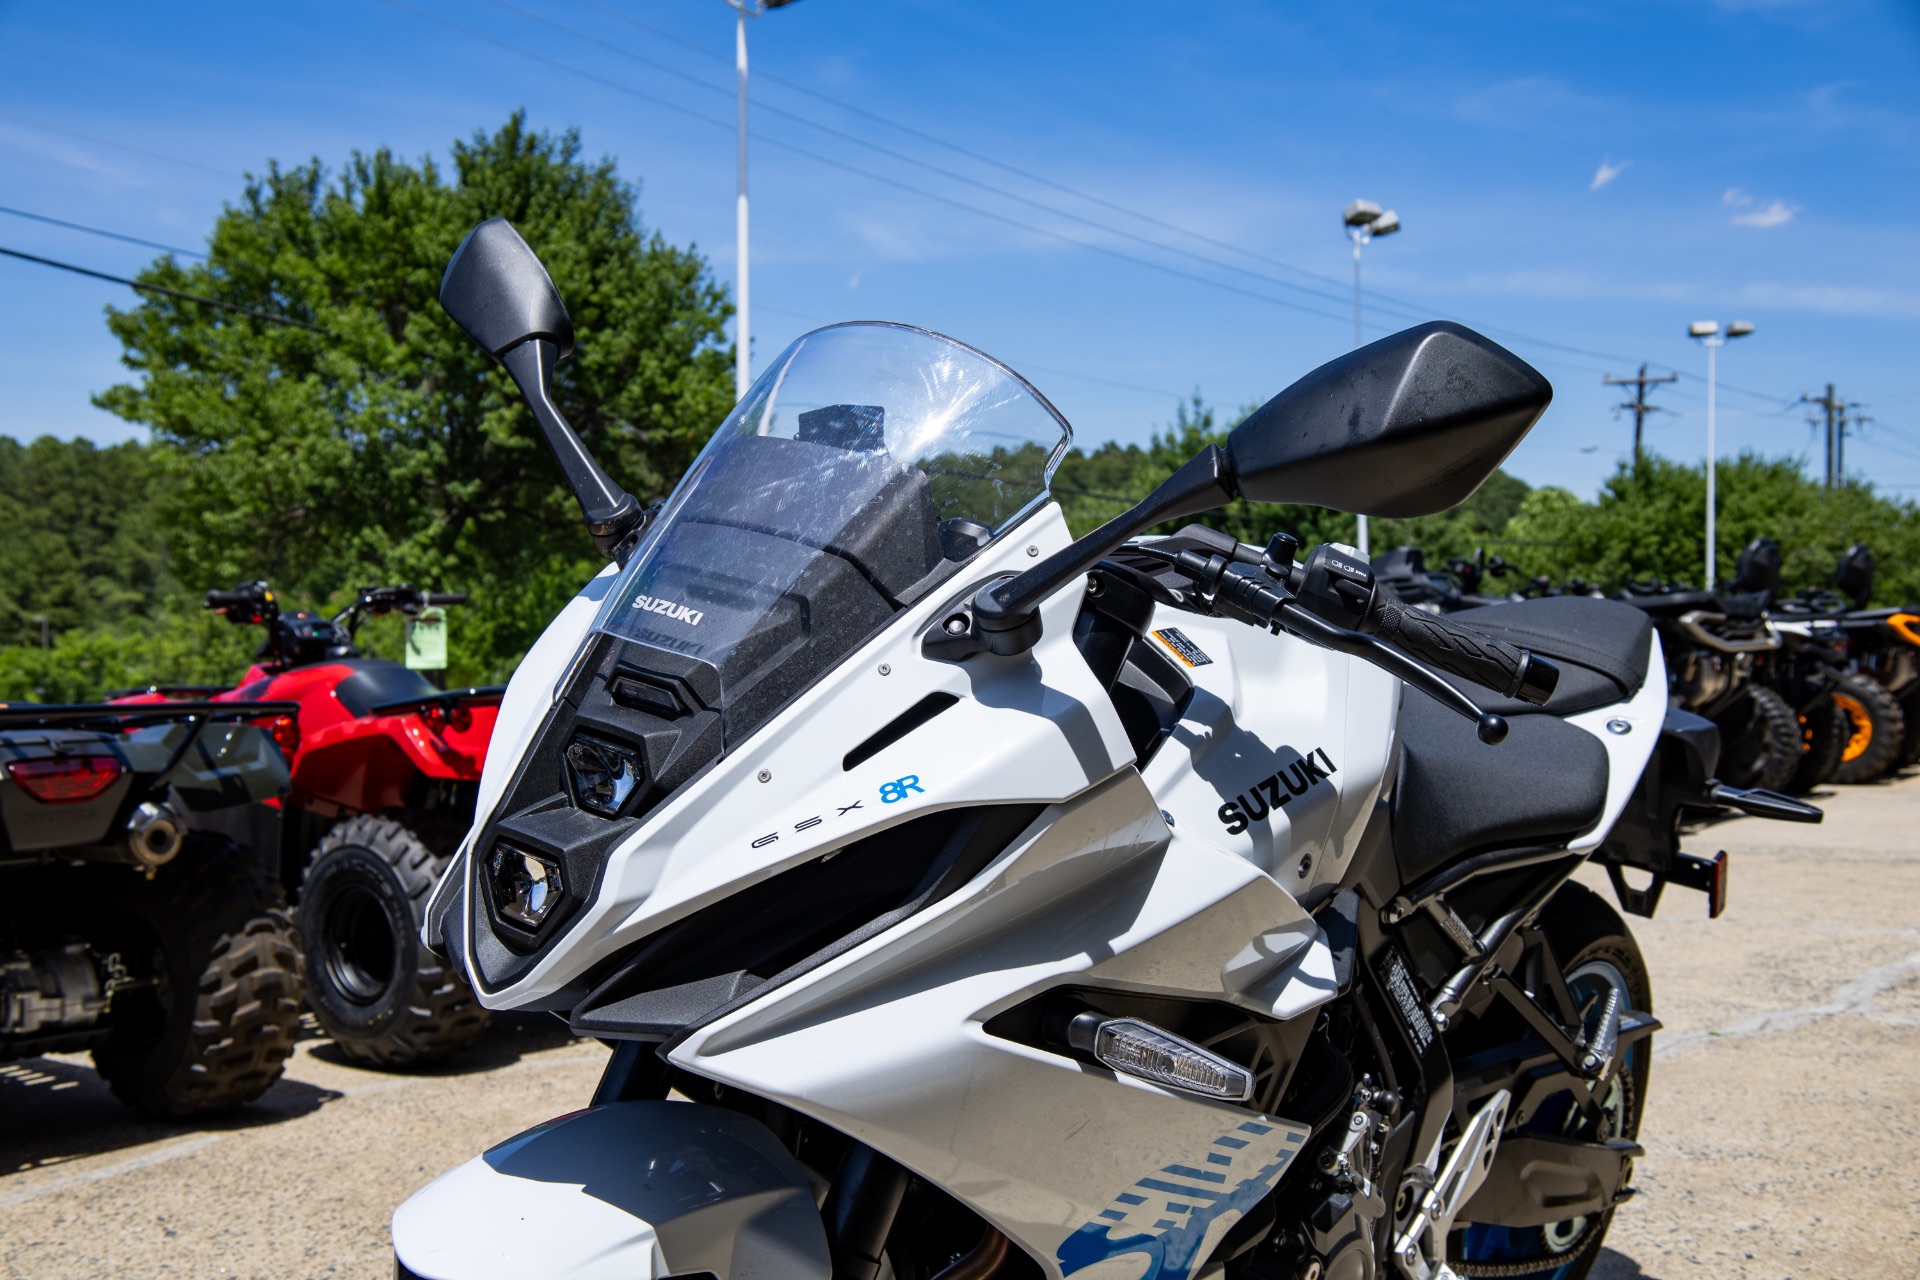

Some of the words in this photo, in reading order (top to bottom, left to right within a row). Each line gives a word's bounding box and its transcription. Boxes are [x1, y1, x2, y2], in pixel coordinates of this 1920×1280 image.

[632, 595, 704, 626] SUZUKI
[751, 800, 864, 849] GSX
[878, 774, 926, 804] 8R
[1217, 747, 1338, 836] SUZUKI
